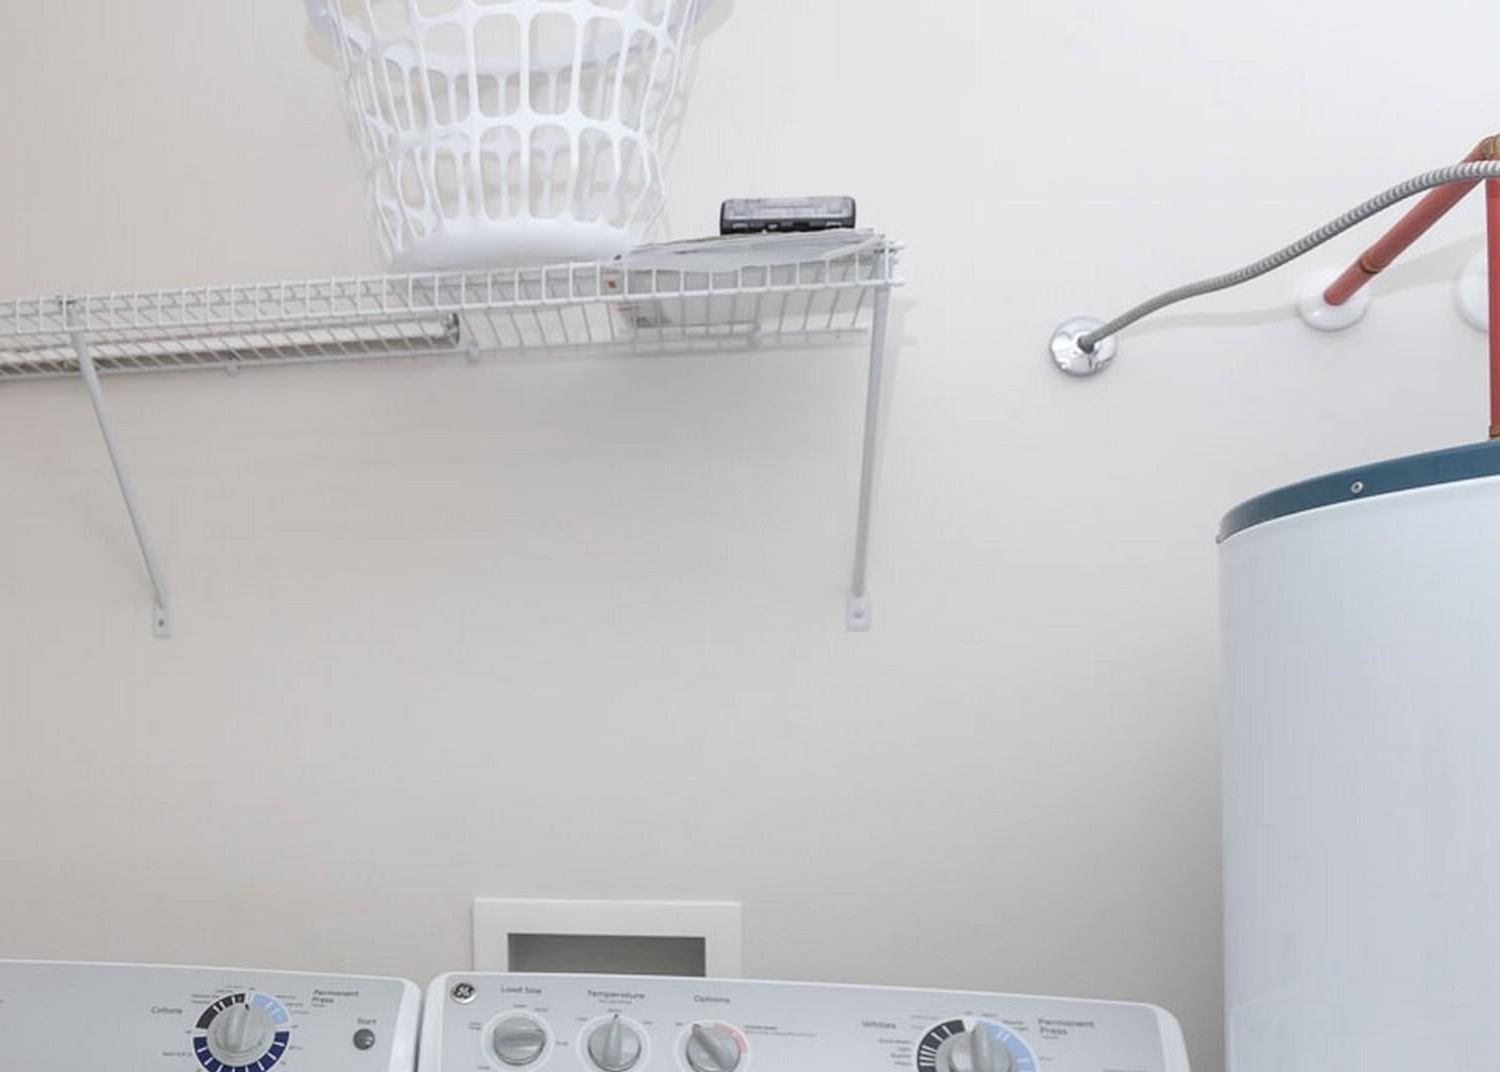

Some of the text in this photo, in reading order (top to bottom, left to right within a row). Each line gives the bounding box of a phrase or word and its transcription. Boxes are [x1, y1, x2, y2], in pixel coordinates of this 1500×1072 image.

[313, 989, 359, 998] Permanent
[588, 989, 645, 999] Temperature
[693, 994, 731, 1004] Options
[357, 1017, 377, 1025] Start
[1038, 1018, 1094, 1029] Permanent
